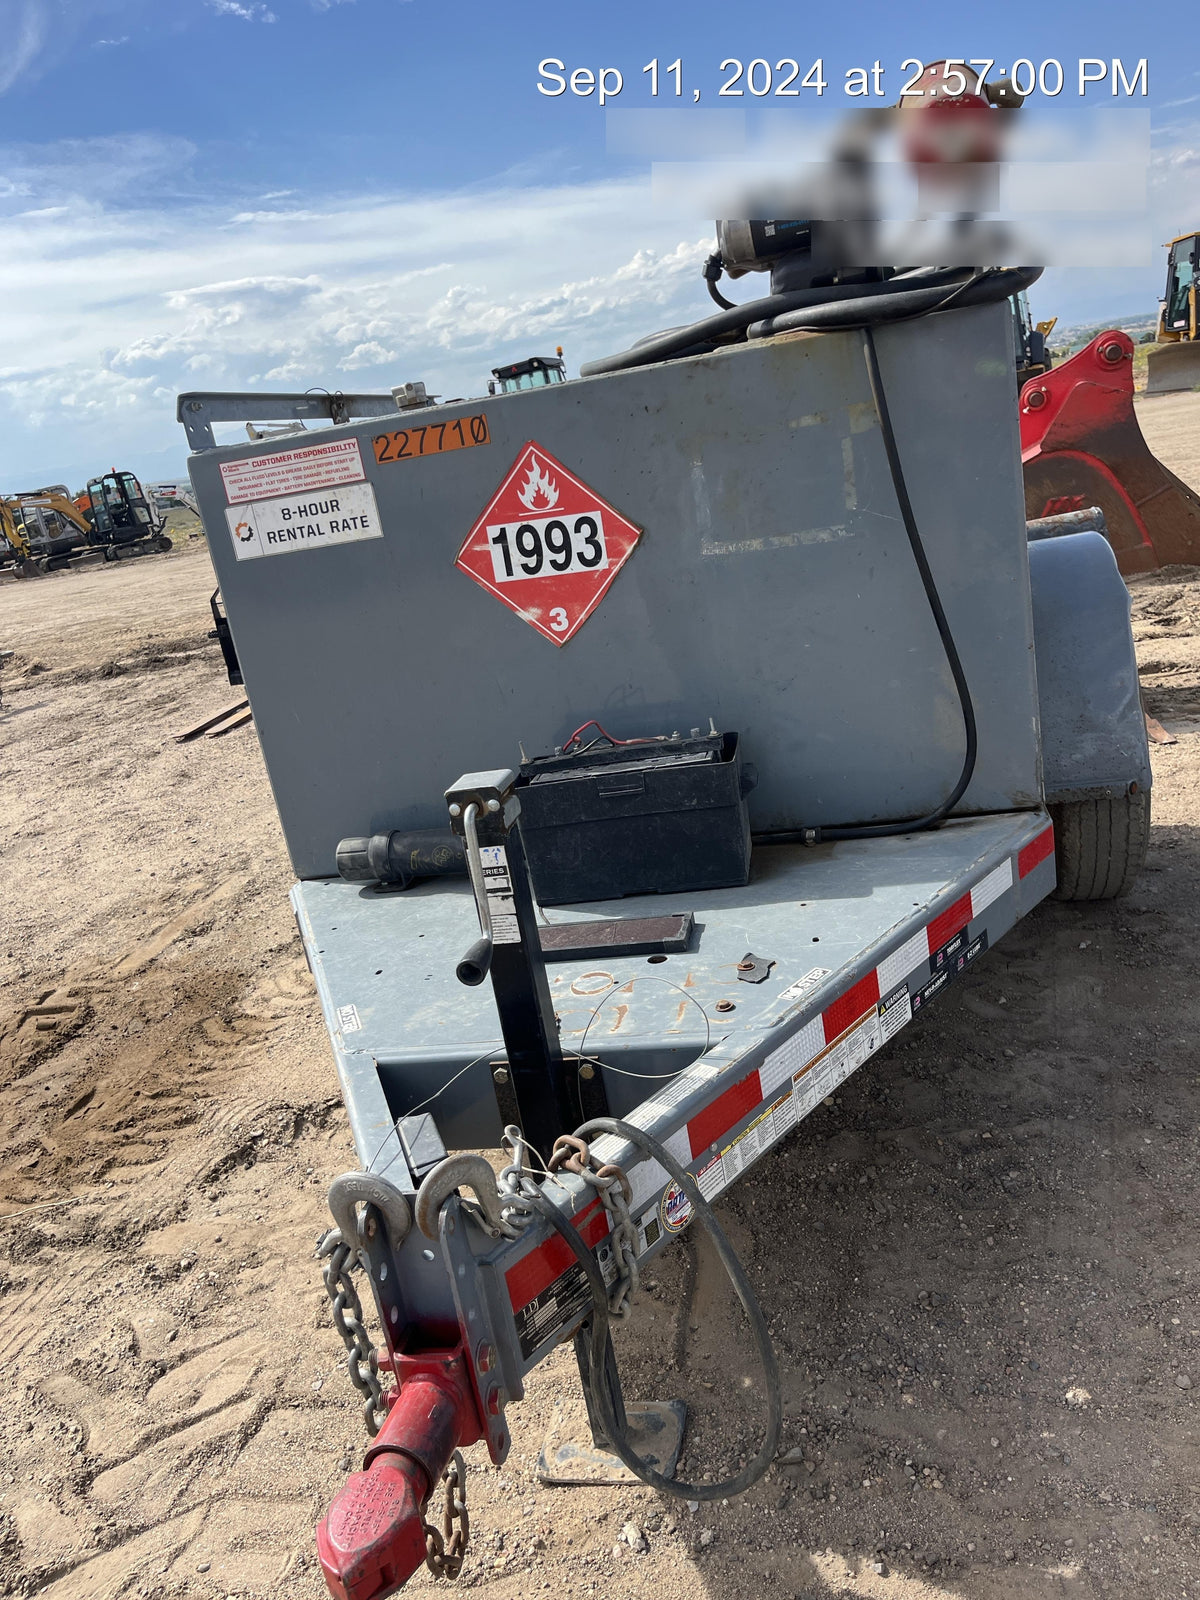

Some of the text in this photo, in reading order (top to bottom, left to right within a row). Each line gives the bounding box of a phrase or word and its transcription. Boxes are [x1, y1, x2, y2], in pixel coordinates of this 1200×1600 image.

[375, 414, 487, 462] 227710
[252, 442, 357, 468] CUSTOMER RESPONSIBILITY
[317, 462, 334, 470] BEFORE
[238, 483, 262, 491] INSURANCE
[256, 487, 282, 496] EQUIPMENT
[284, 482, 303, 491] BATTERY
[304, 478, 336, 488] MAINTENANCE
[338, 472, 362, 481] CLEANING
[281, 499, 341, 521] 8-HOUR
[266, 515, 370, 544] RENTAL RATE
[492, 516, 602, 577] 1993
[549, 607, 569, 632] 3
[885, 984, 908, 1009] WARNING
